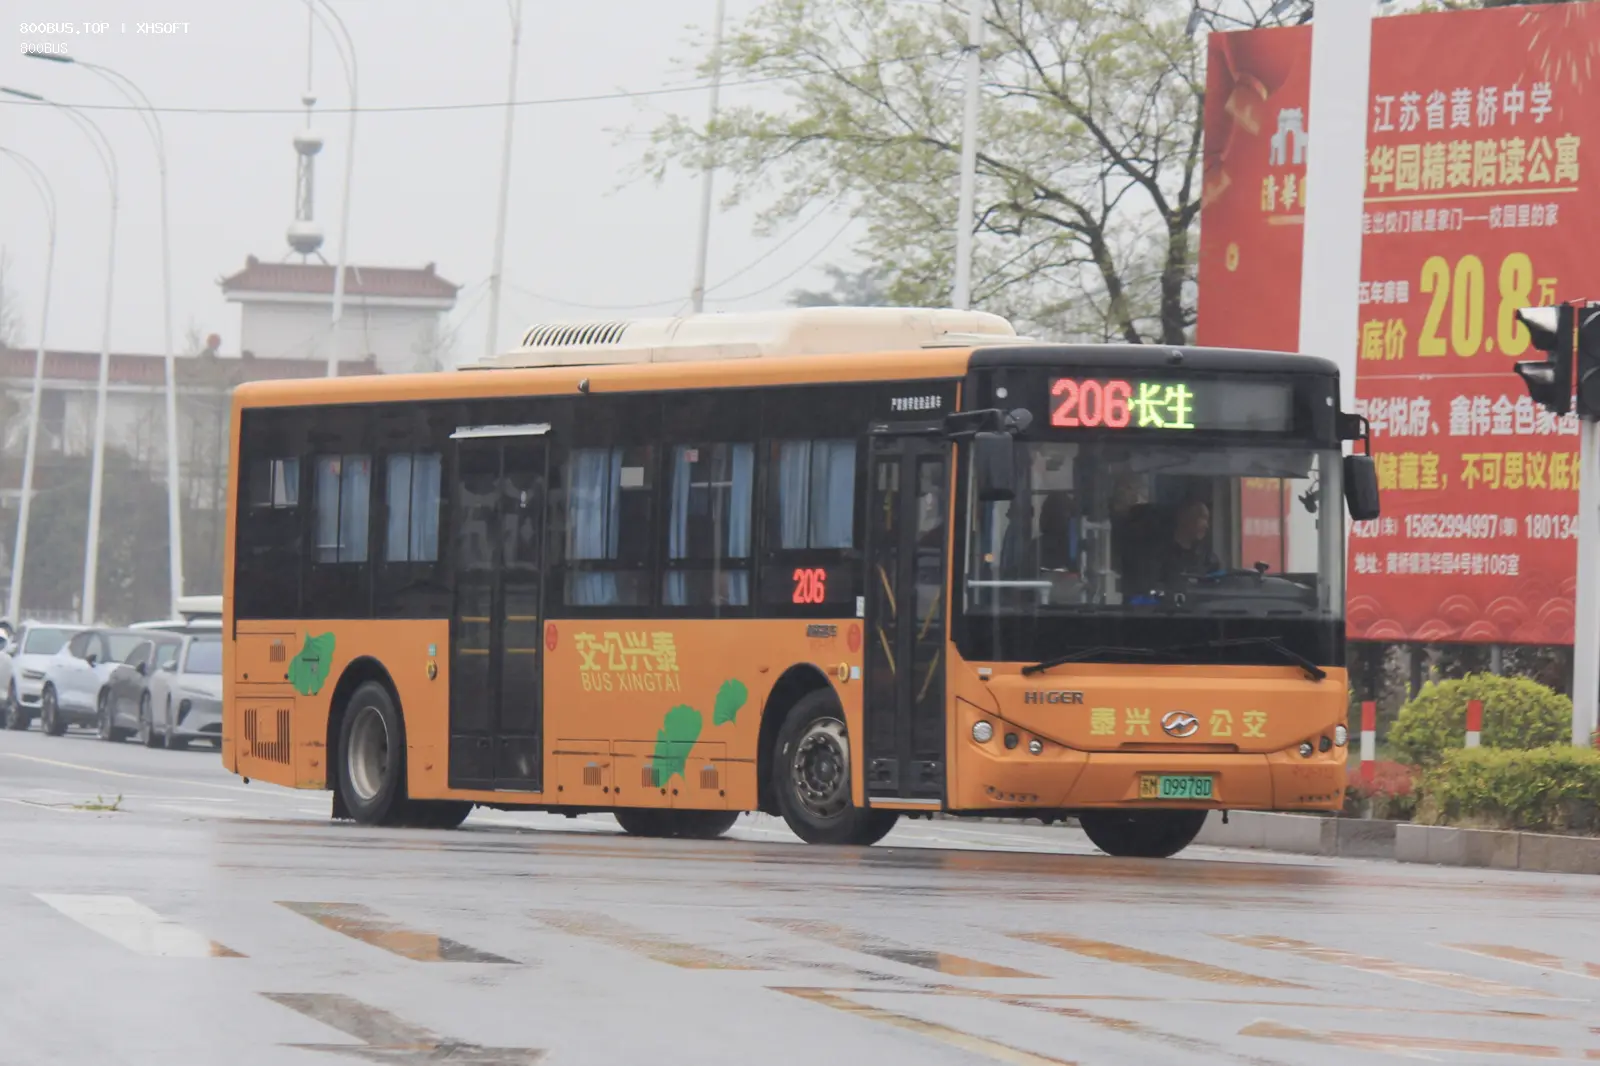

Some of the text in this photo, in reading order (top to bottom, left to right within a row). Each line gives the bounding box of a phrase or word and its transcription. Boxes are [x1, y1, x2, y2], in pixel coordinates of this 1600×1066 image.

[1373, 82, 1553, 132] 江苏省黄桥中学
[1363, 133, 1581, 193] 华园精装陪读公寓
[1357, 318, 1407, 360] 底价
[1050, 378, 1195, 430] 206 长生
[792, 568, 826, 604] 206
[580, 672, 681, 693] BUS XINGTAI
[1024, 690, 1084, 705] HIGER
